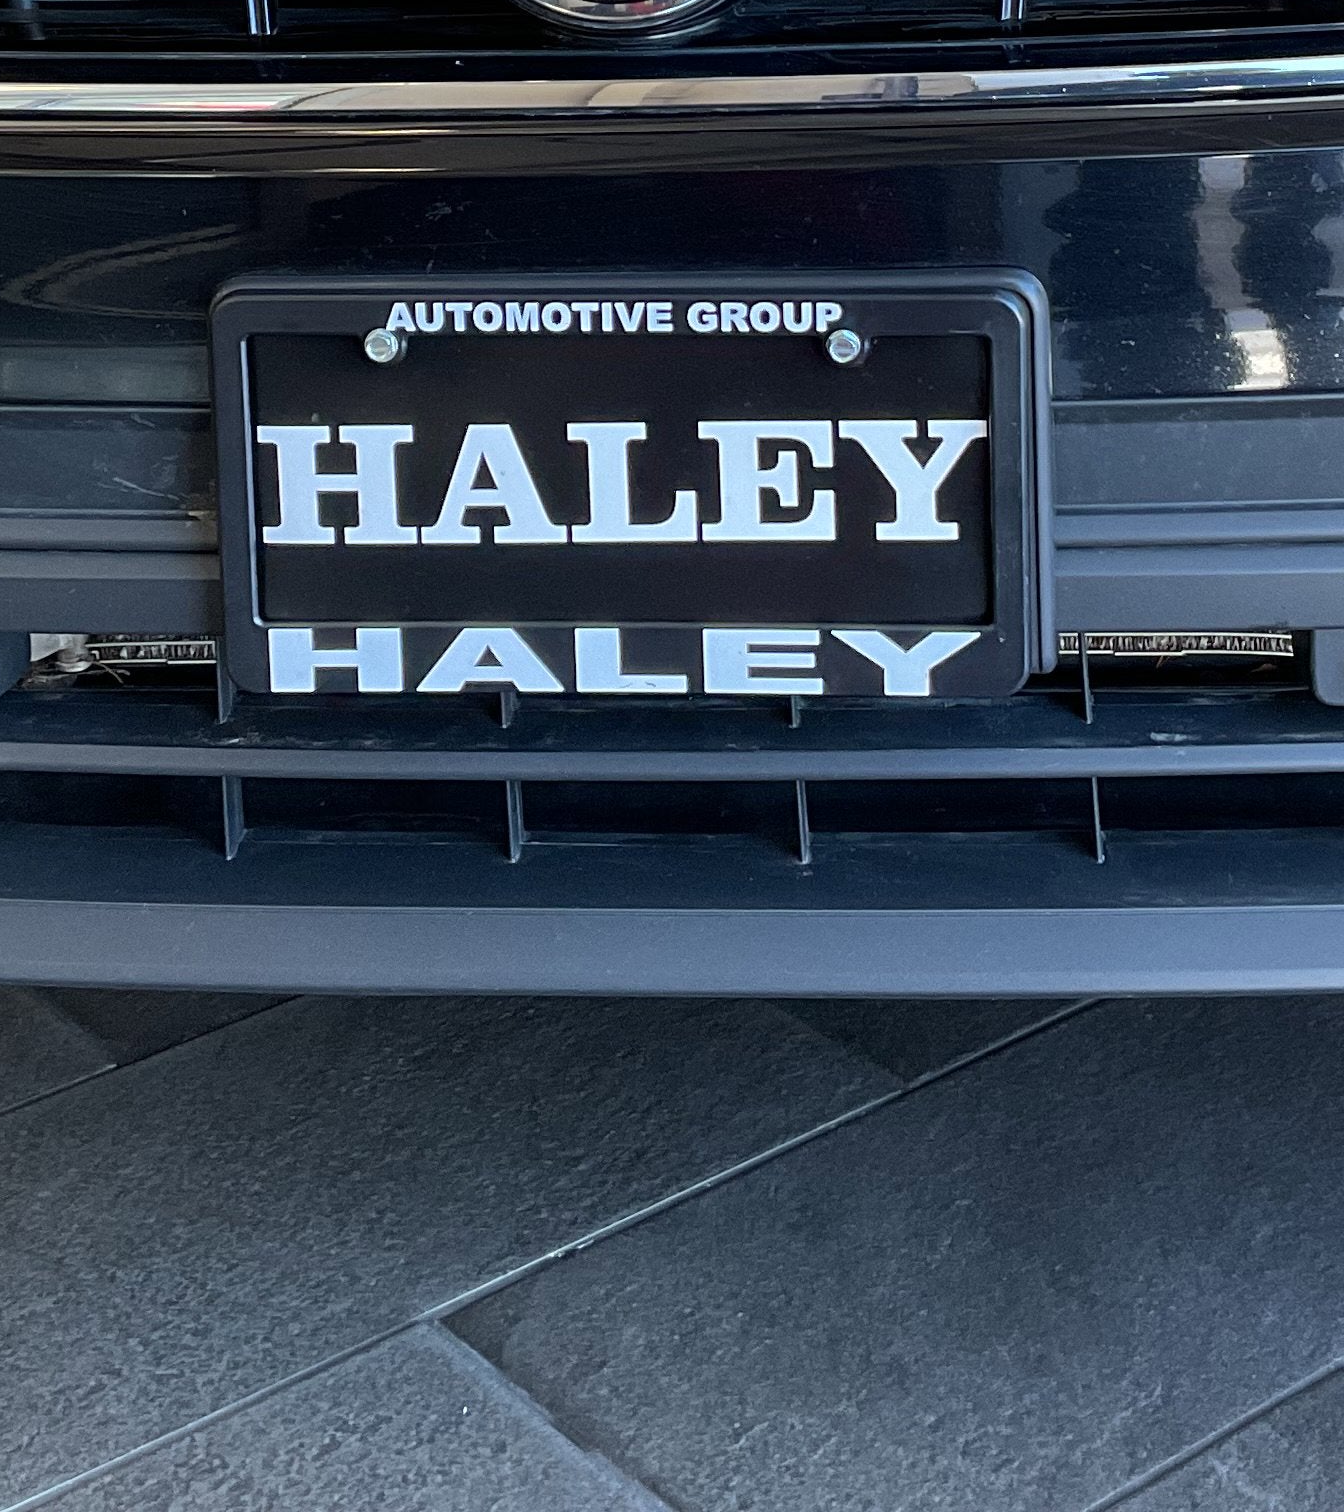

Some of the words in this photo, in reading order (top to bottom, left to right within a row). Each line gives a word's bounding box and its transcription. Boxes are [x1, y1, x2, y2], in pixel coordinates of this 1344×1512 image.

[385, 300, 673, 334] AUTOMOTIVE
[685, 300, 843, 334] GROUP
[256, 419, 989, 545] HALEY
[266, 626, 982, 696] HALEY
